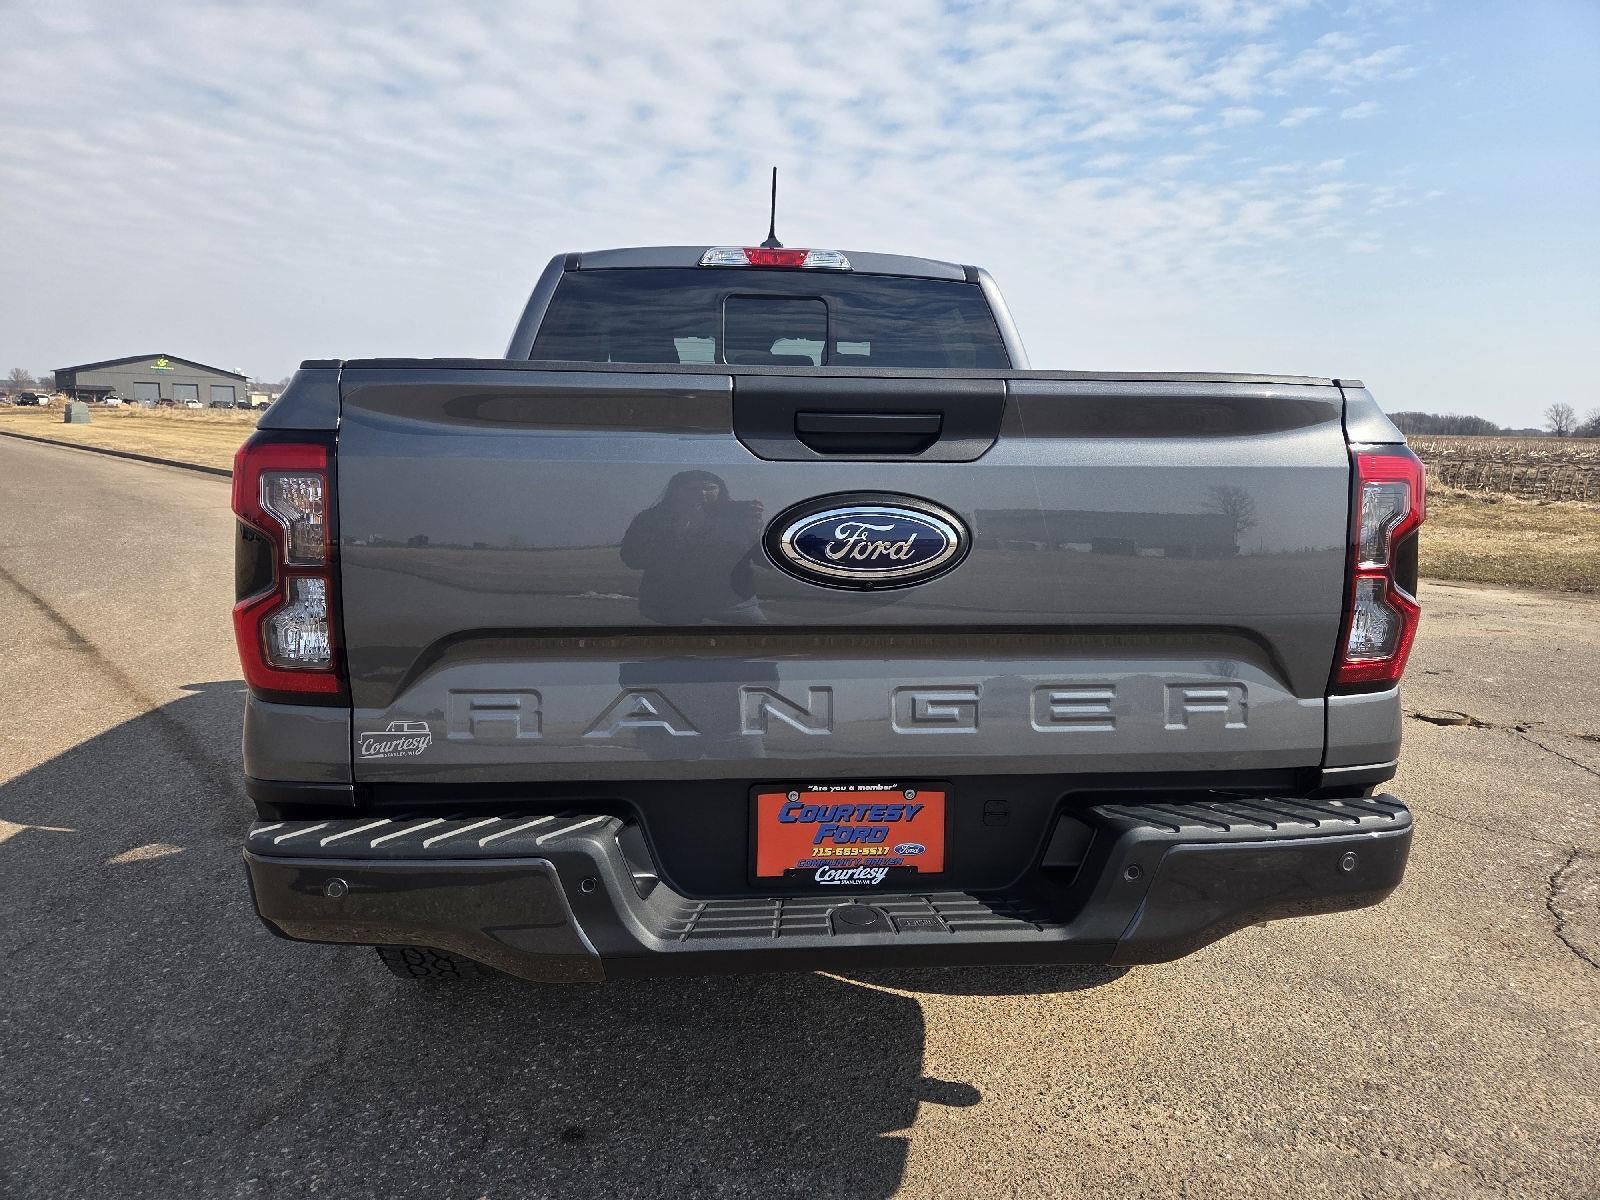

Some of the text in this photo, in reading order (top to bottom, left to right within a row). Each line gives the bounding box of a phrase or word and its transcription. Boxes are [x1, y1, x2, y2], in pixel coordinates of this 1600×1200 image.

[825, 521, 917, 561] Ford
[447, 682, 1249, 740] RANGER
[361, 736, 430, 756] Courtesy
[829, 785, 847, 793] you
[777, 801, 925, 824] COURTESY
[812, 823, 890, 845] FORD
[899, 844, 921, 854] Ford
[814, 865, 890, 885] Courtesy
